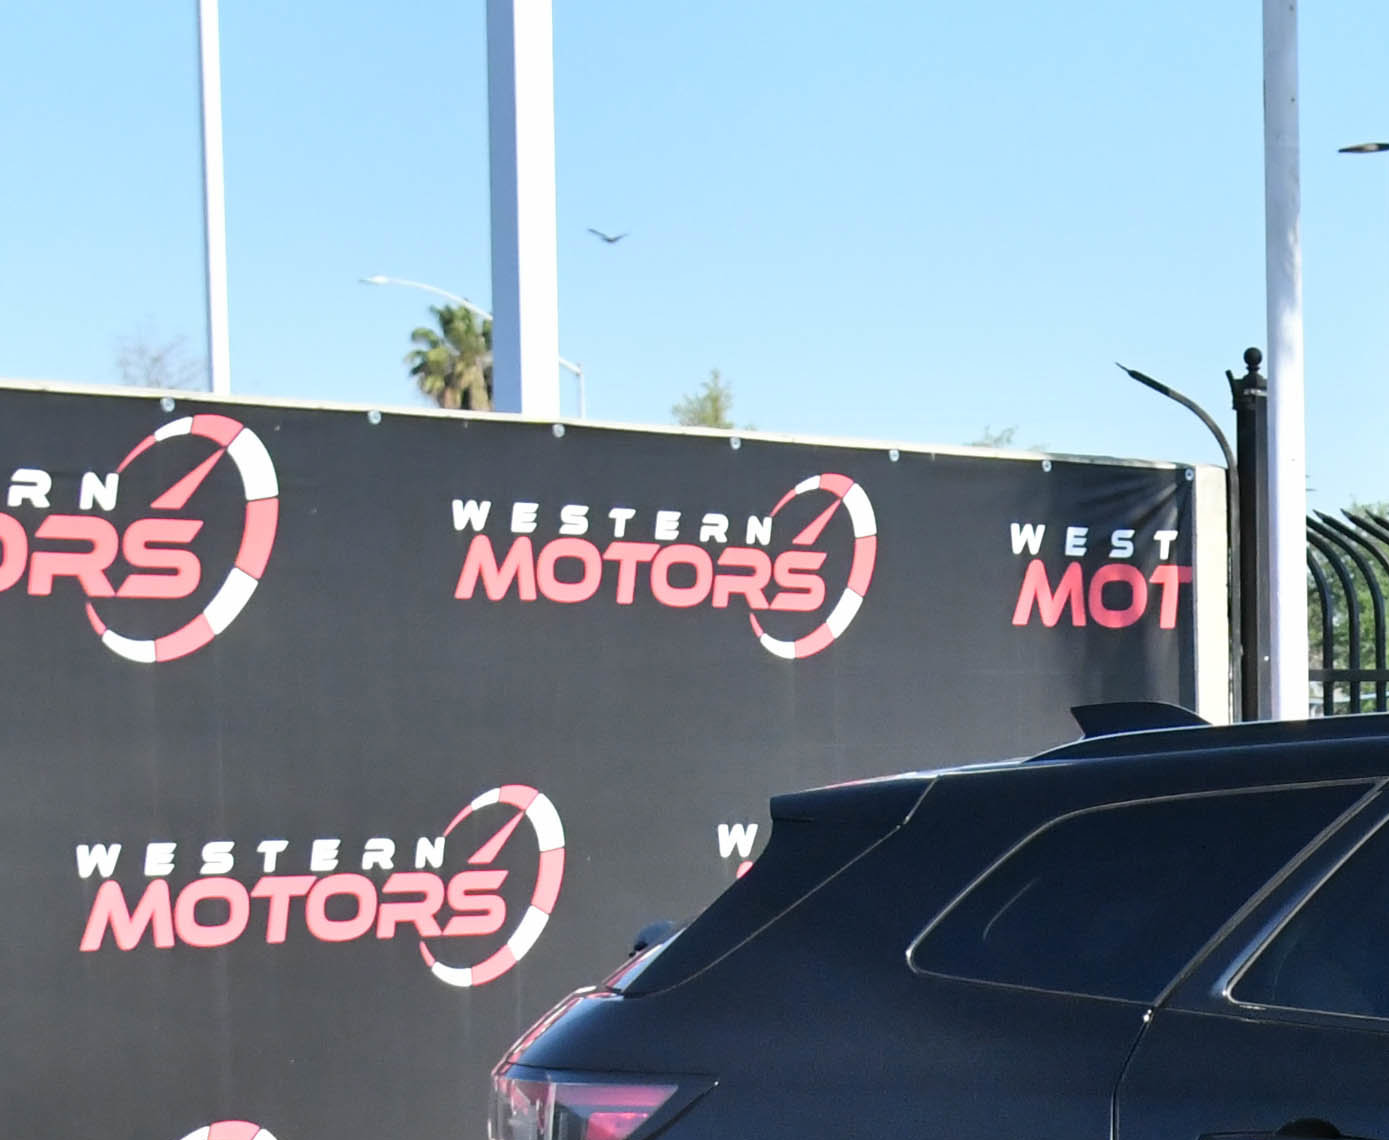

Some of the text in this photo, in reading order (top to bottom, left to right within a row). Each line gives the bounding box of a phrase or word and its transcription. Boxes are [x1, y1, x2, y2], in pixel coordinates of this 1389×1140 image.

[452, 500, 773, 546] WESTERN
[1010, 522, 1178, 560] WEST
[455, 534, 827, 612] MOTORS
[1011, 558, 1193, 630] MOT
[76, 837, 446, 878] WESTERN
[80, 869, 510, 952] MOTORS
